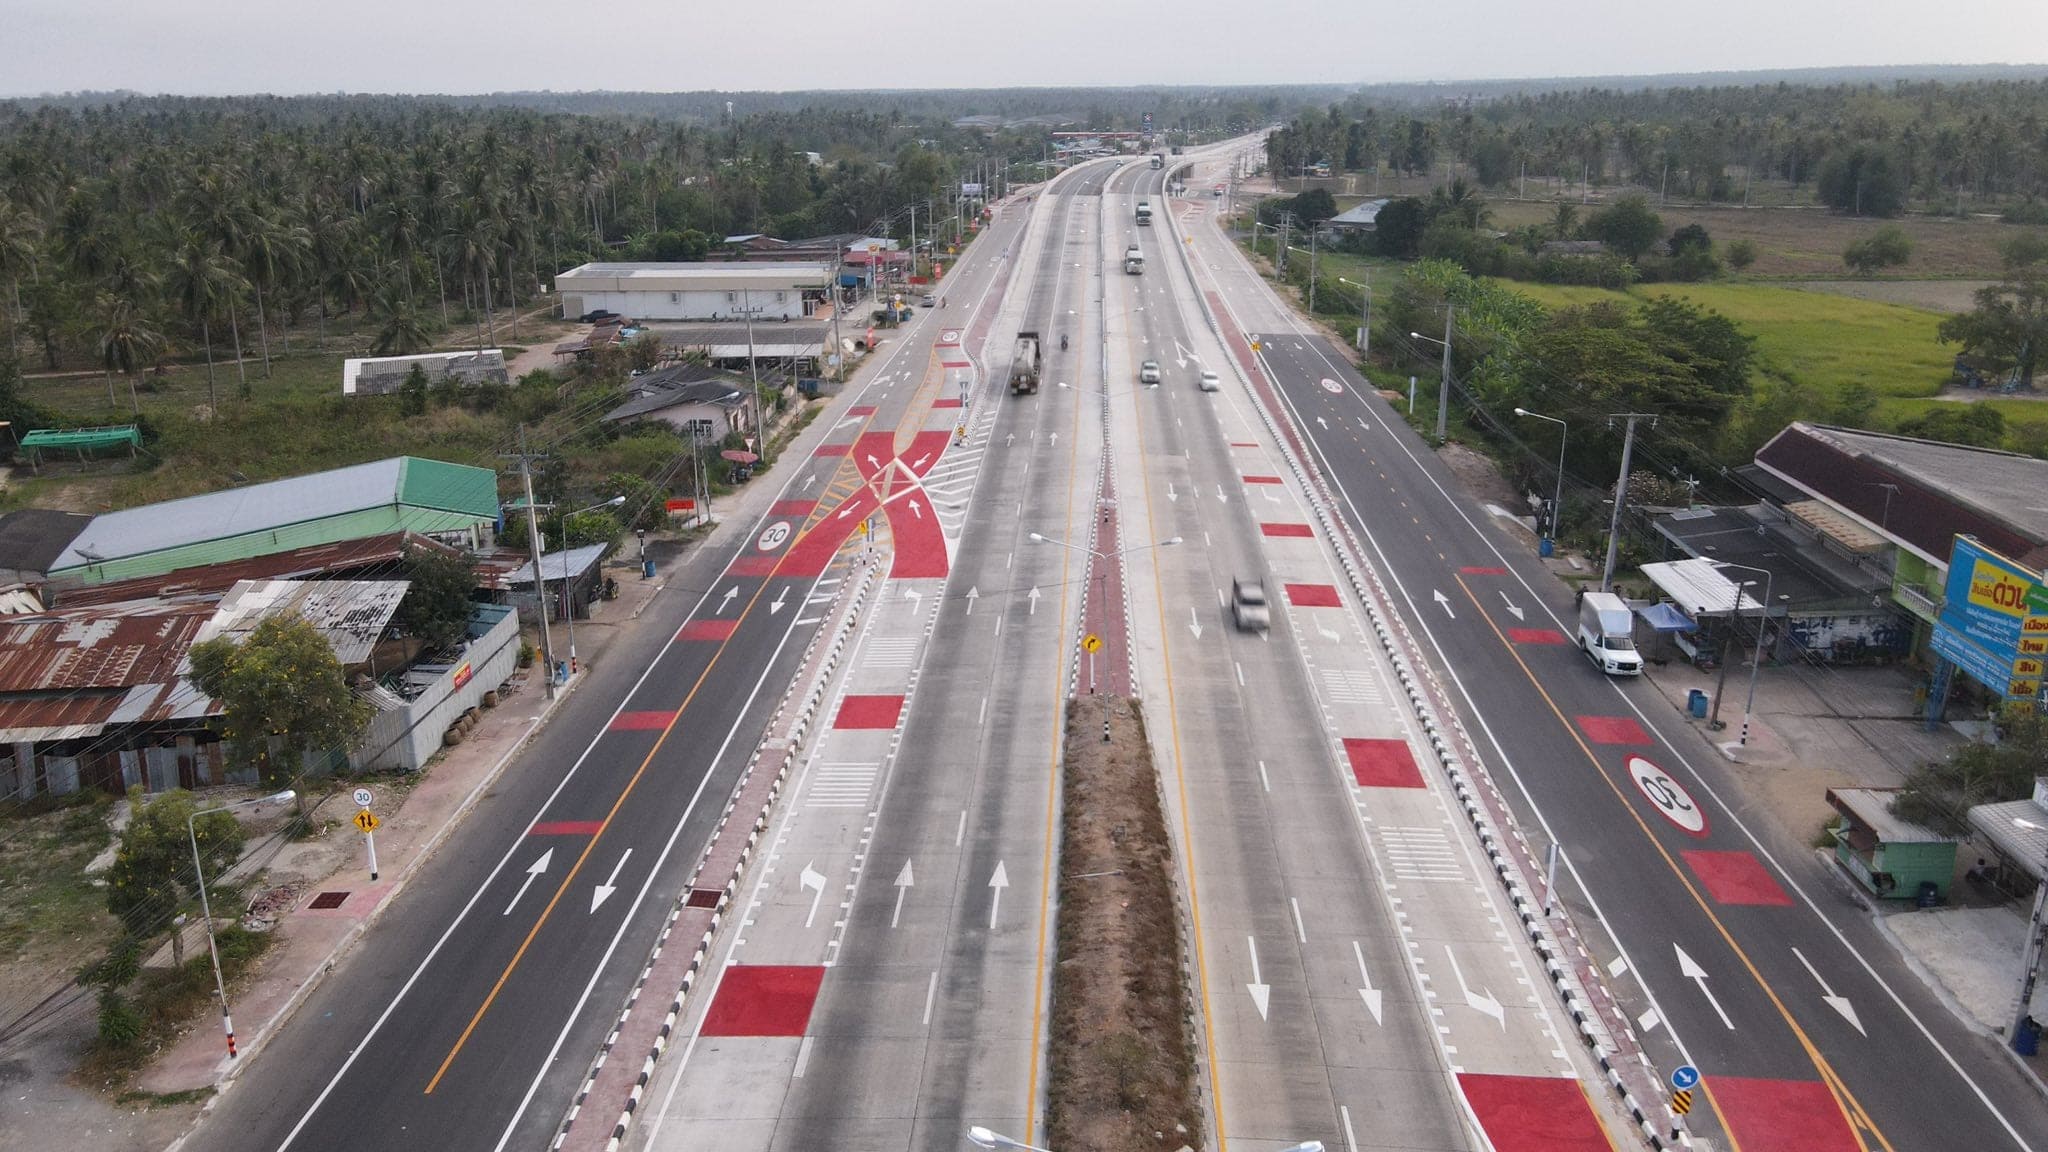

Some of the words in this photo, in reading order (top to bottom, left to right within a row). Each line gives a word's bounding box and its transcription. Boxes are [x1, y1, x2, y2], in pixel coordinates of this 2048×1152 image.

[761, 528, 787, 543] 30
[356, 792, 370, 802] 30
[1640, 775, 1692, 811] 30
